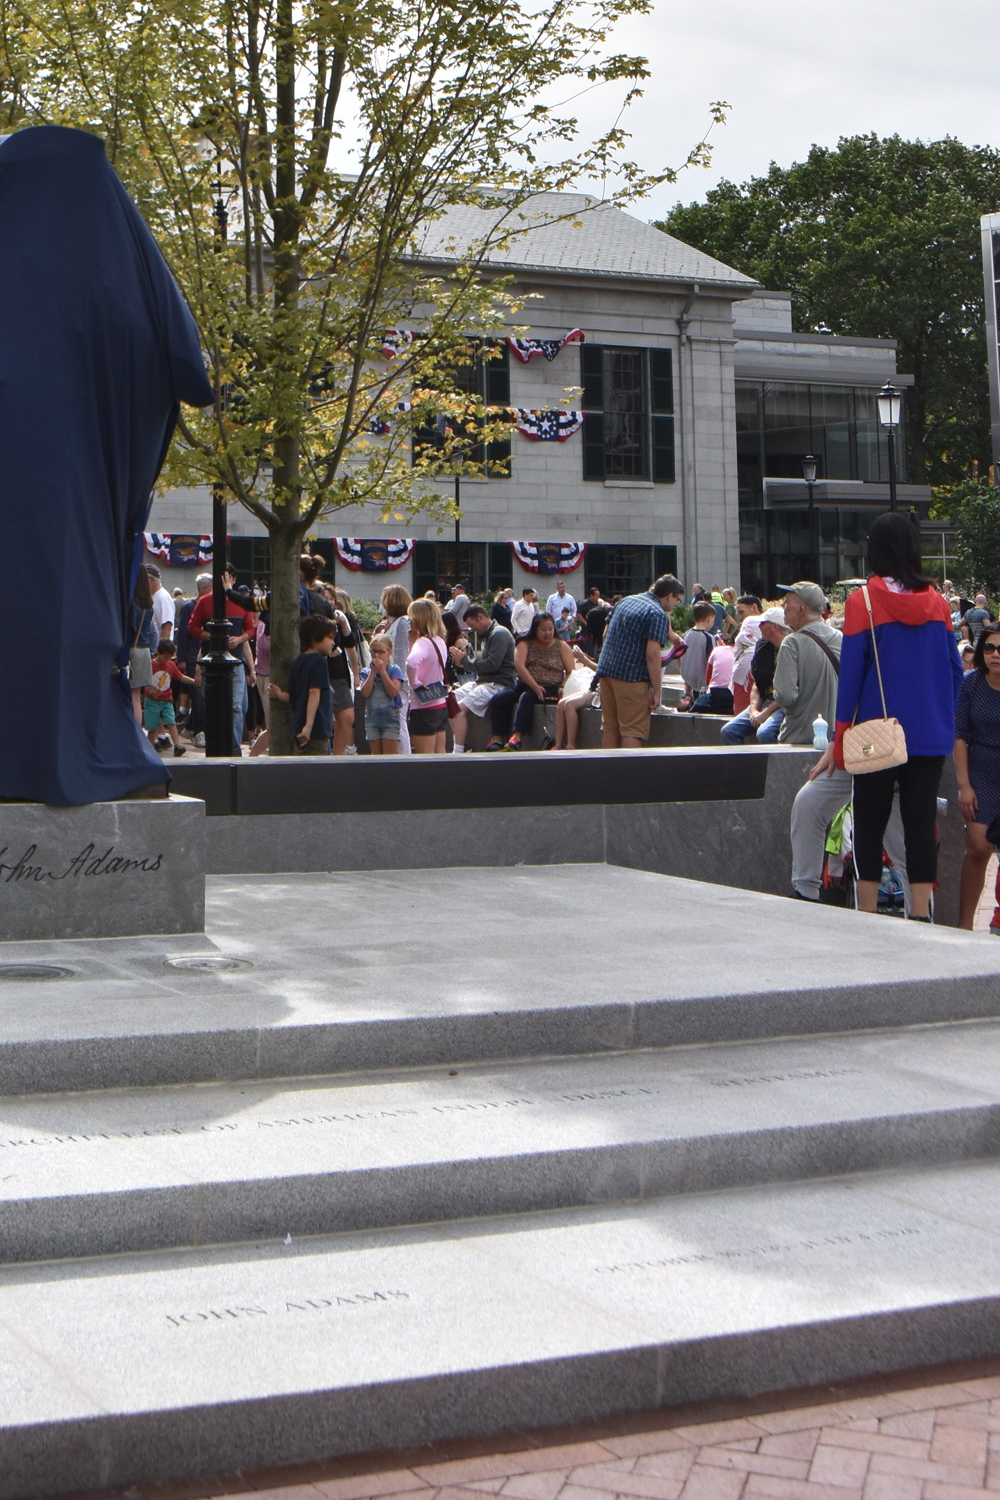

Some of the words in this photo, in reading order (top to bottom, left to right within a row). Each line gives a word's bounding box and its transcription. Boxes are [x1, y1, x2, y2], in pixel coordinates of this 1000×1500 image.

[48, 843, 164, 880] Adams
[200, 1121, 239, 1134] OF
[257, 1107, 419, 1129] AMERICAN
[165, 1305, 268, 1328] JOHN
[285, 1289, 410, 1313] ADAMS
